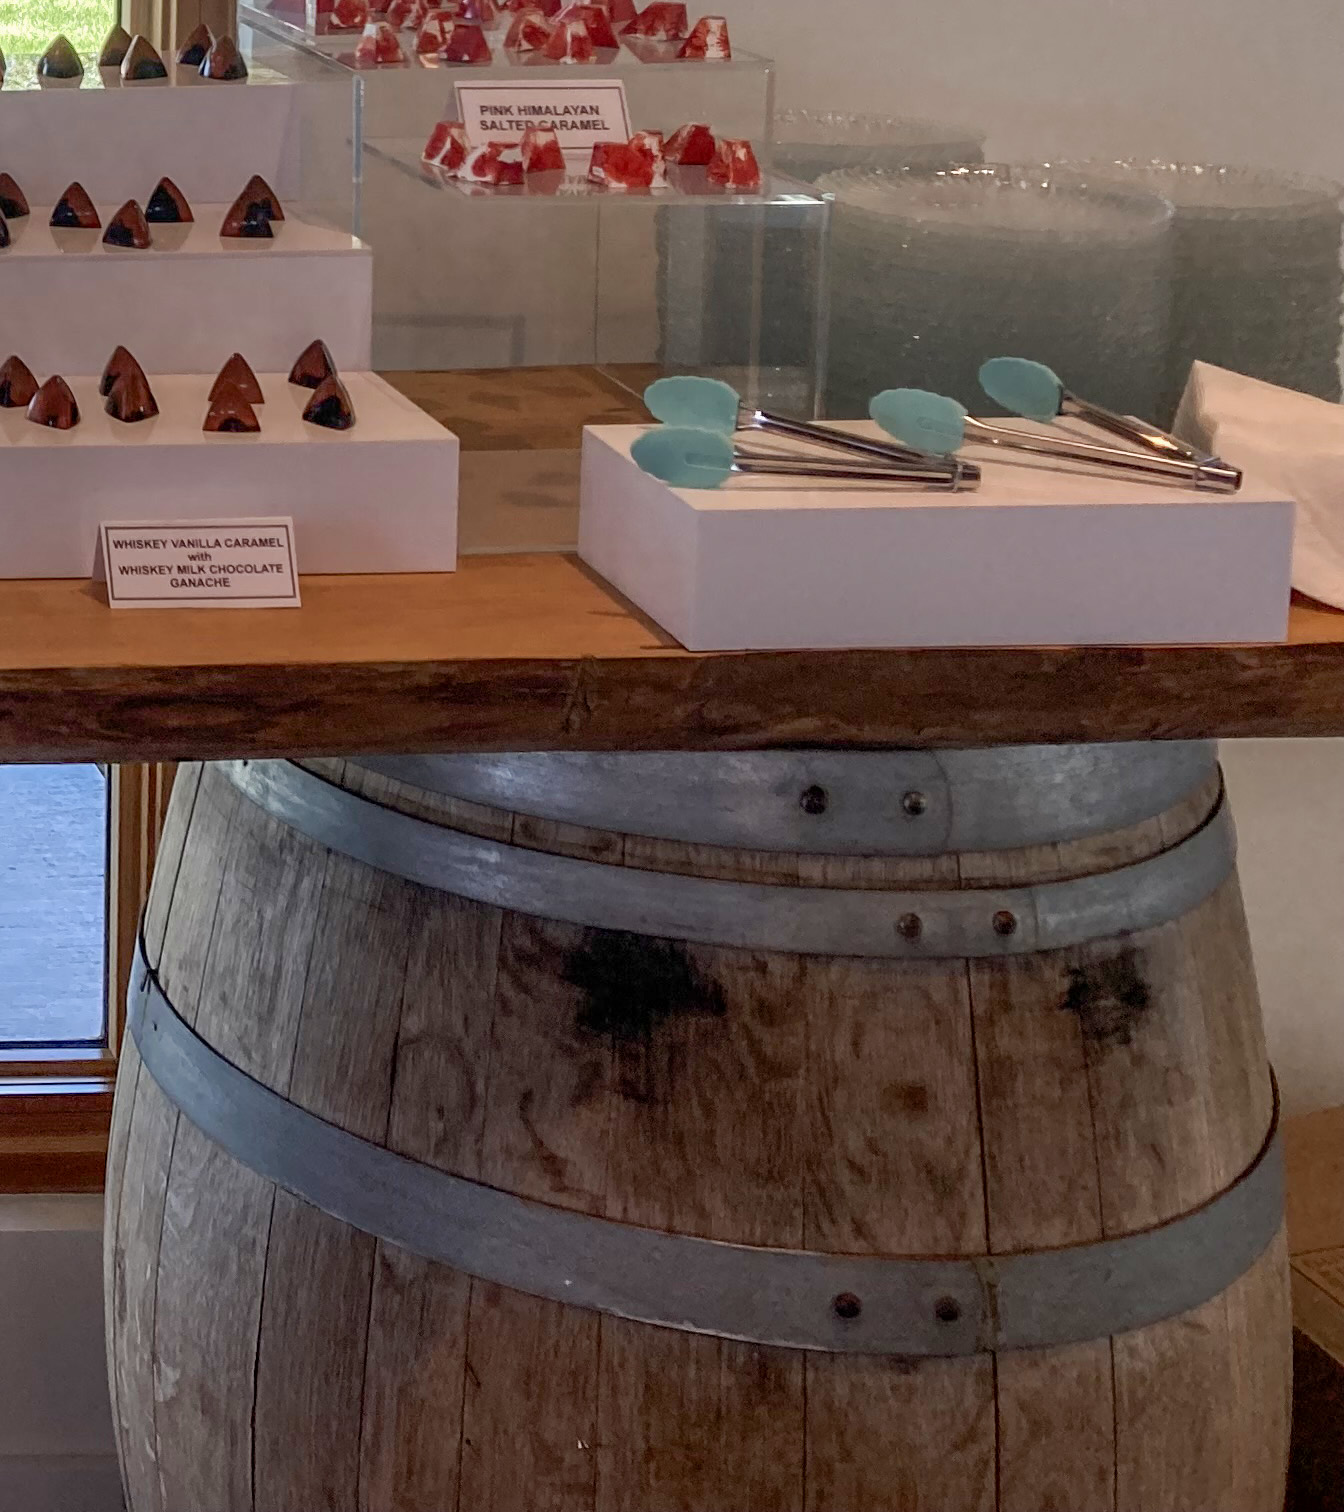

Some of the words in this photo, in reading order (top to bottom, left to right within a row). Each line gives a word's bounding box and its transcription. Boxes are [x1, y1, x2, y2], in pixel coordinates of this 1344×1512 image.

[479, 105, 514, 116] PINK
[517, 105, 600, 115] HIMALAYAN
[480, 120, 535, 131] SALTED
[538, 120, 610, 130] CARAMEL
[113, 539, 167, 549] WHISKEY
[171, 538, 222, 549] VANILLA
[224, 538, 284, 548] CARAMEL
[188, 552, 211, 562] with
[118, 565, 173, 575] WHISKEY
[177, 564, 206, 575] MILK
[209, 564, 284, 574] CHOCOLATE
[170, 577, 231, 588] GANACHE
